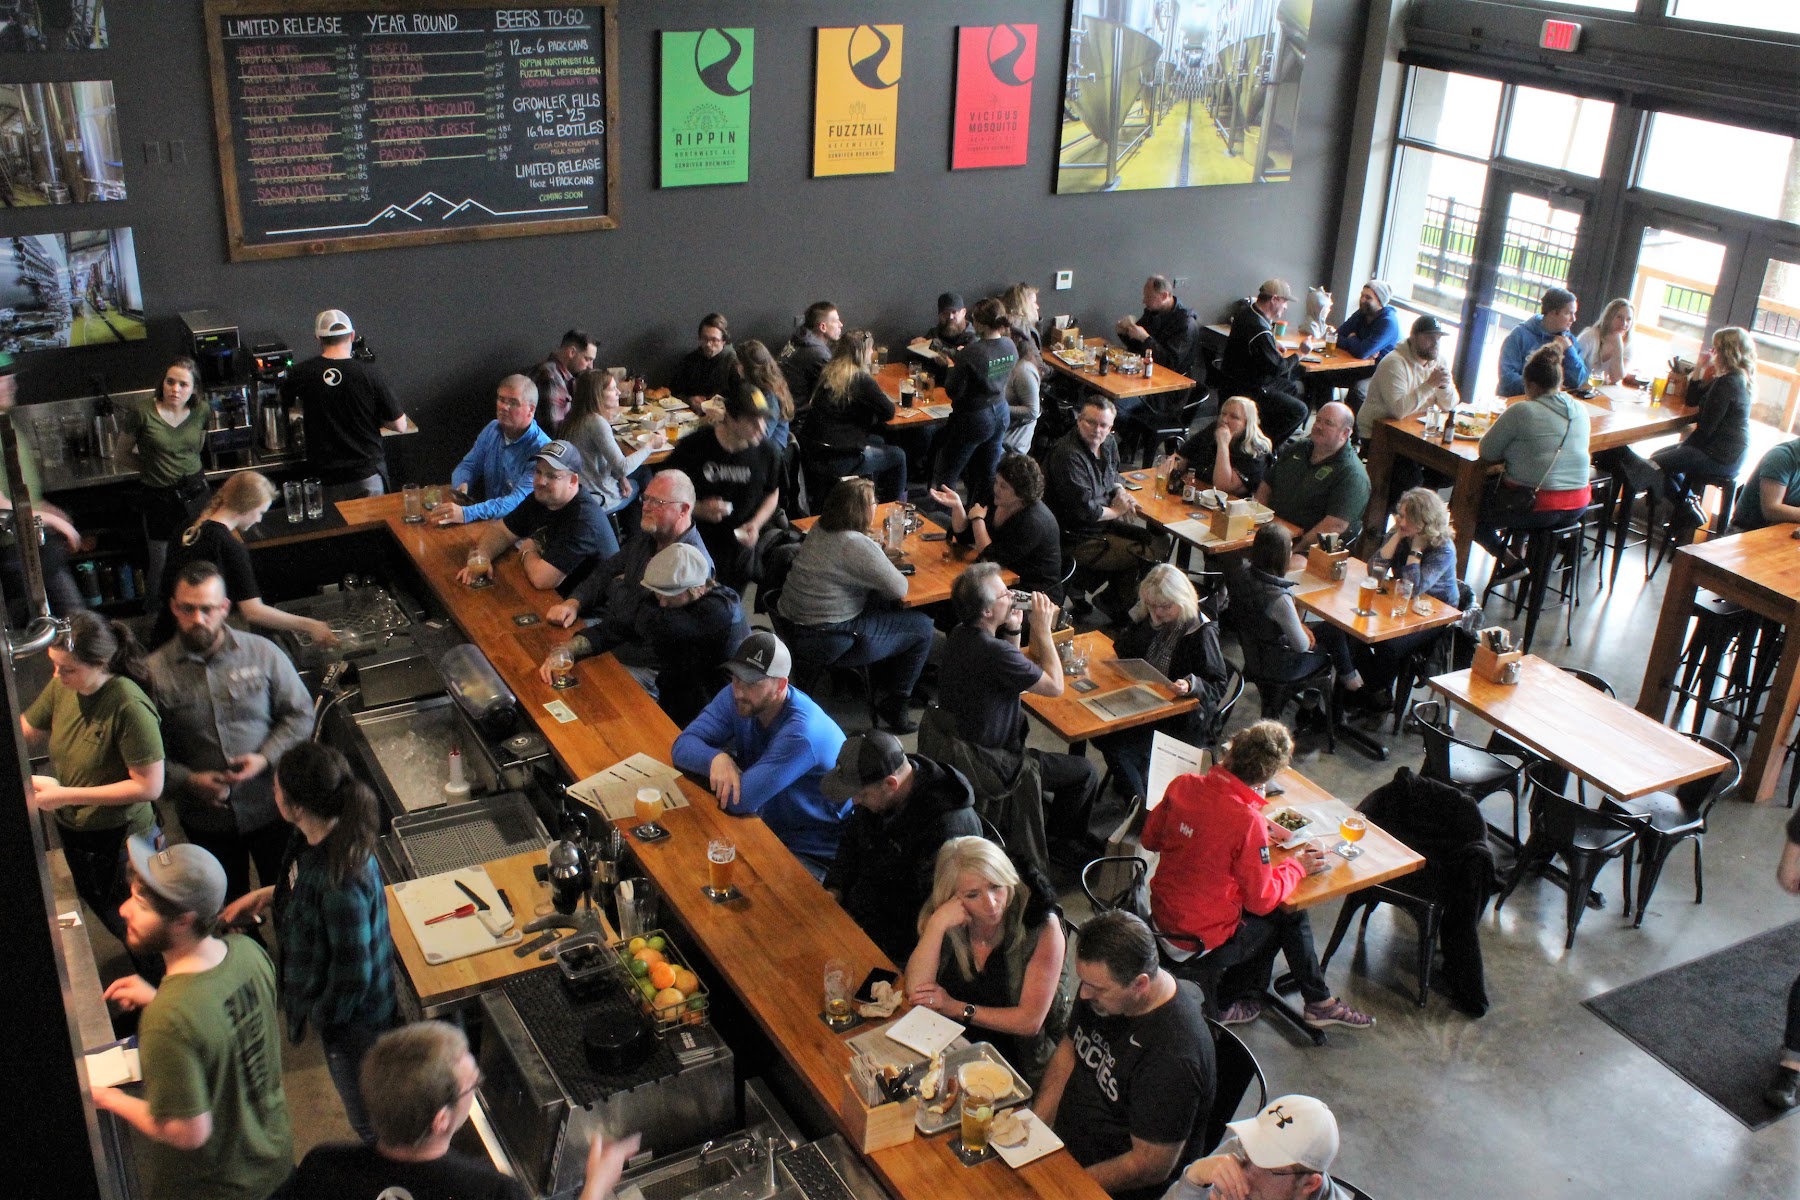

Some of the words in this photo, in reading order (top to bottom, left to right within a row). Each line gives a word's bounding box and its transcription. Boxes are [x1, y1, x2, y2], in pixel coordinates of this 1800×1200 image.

[367, 14, 407, 33] YEAR
[413, 14, 458, 32] ROUND
[496, 10, 540, 28] BEERS
[544, 9, 584, 26] TO-GO
[228, 19, 279, 36] LIMITED
[283, 17, 342, 34] RELEASE
[1545, 21, 1575, 50] EXIT
[548, 40, 568, 52] PACK
[568, 38, 588, 51] CANS
[520, 58, 542, 69] RIPPIN
[582, 56, 596, 65] ALE
[520, 68, 555, 78] FUZZTAIL
[376, 104, 420, 119] VICIOUS
[424, 100, 476, 117] MOSQUITO
[512, 94, 568, 112] GROWLER
[572, 93, 600, 108] FILLS
[535, 110, 554, 124] $15
[970, 110, 1018, 122] VICIOUS
[556, 120, 604, 138] BOTTLES
[828, 123, 884, 138] FUZZTAIL
[968, 122, 1017, 133] MOSQUITO
[676, 131, 736, 146] RIPPIN
[515, 162, 556, 178] LIMITED
[558, 158, 601, 175] RELEASE
[550, 177, 555, 187] 4
[556, 176, 574, 187] PACK
[574, 176, 594, 186] CANS
[256, 184, 324, 199] SASQUATCH
[538, 192, 562, 202] COMING
[564, 190, 584, 200] SOON
[1180, 822, 1194, 838] HH
